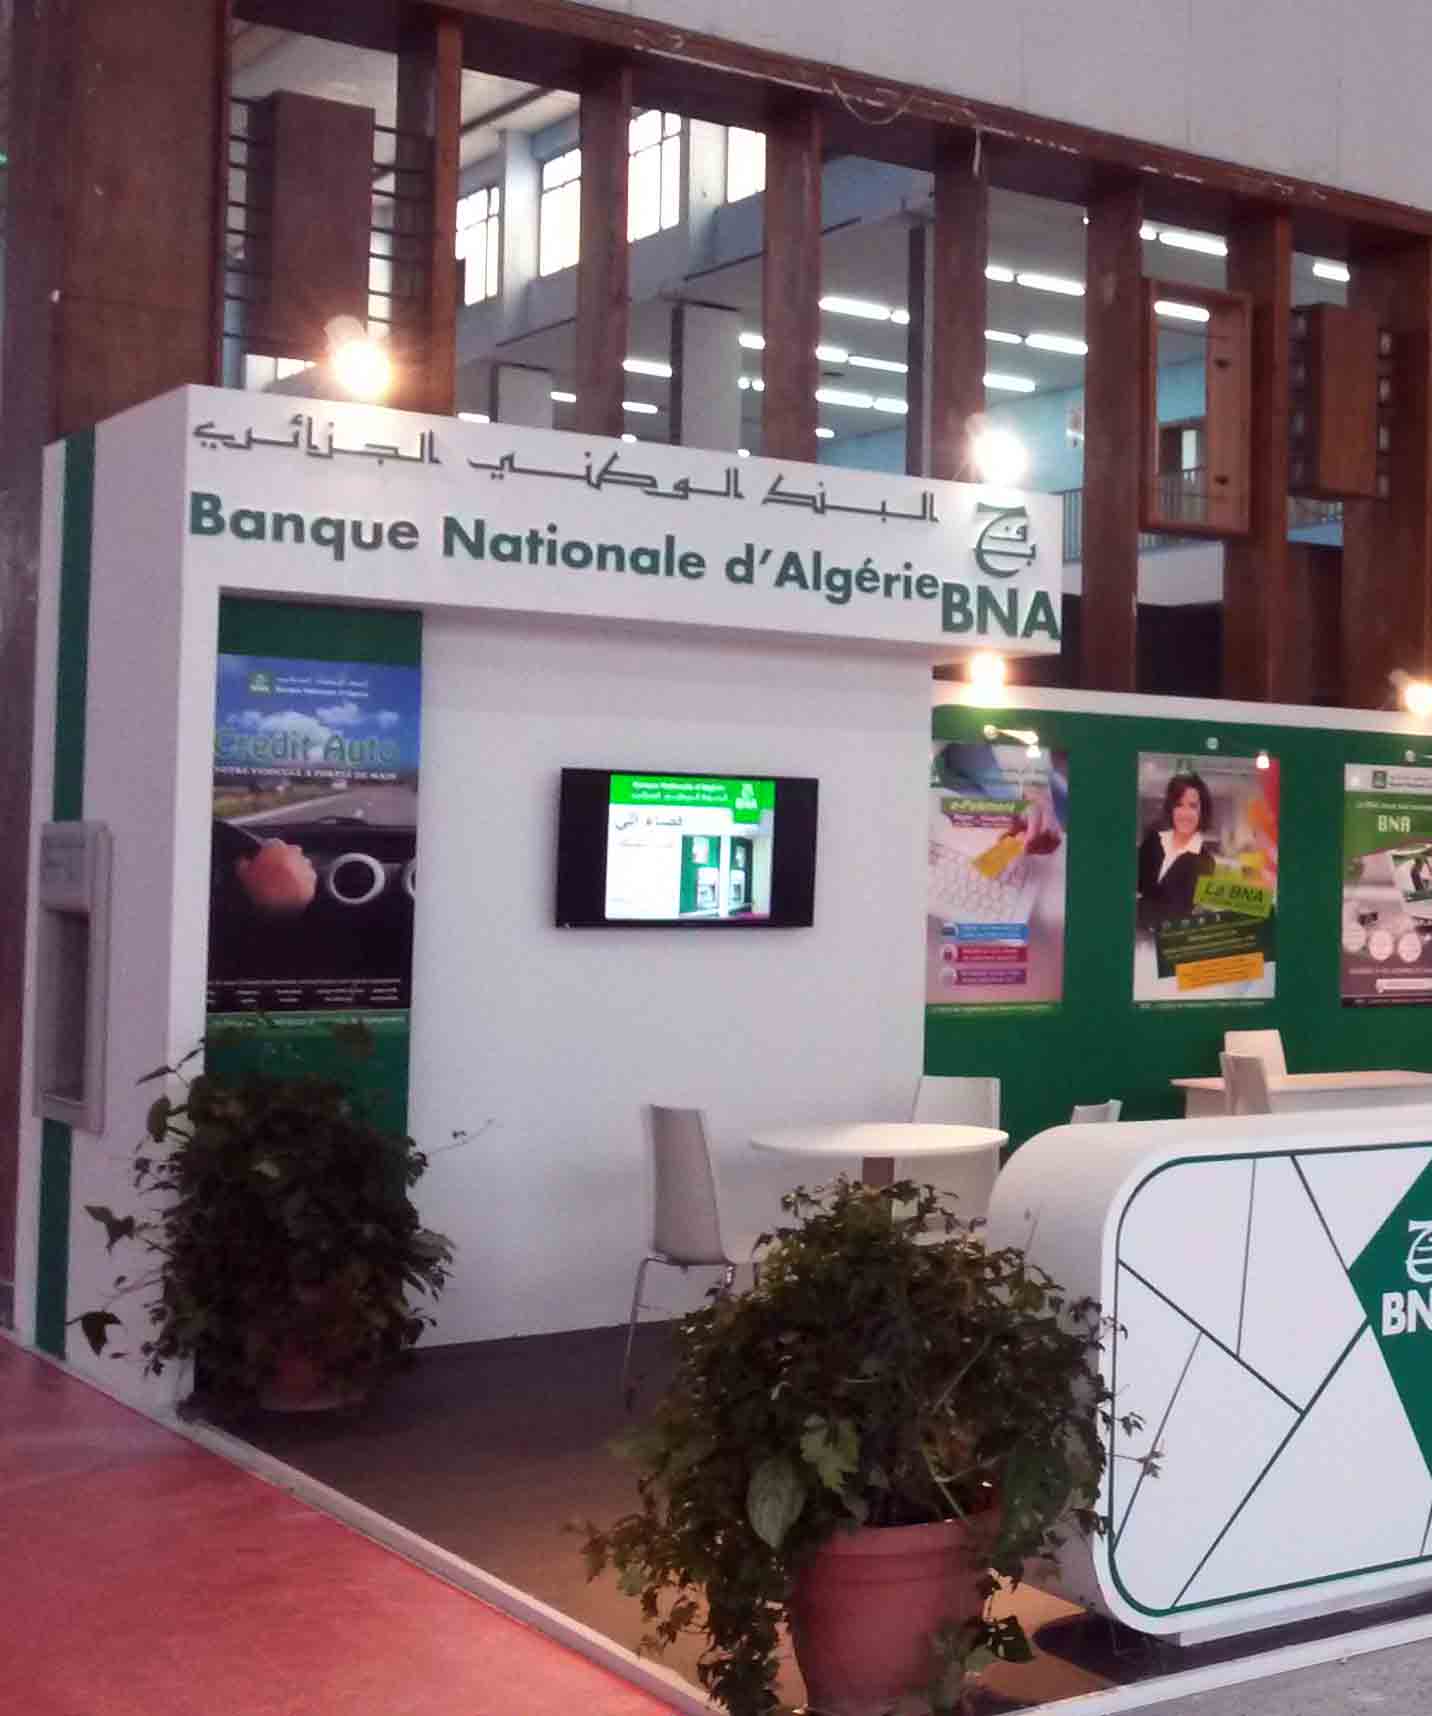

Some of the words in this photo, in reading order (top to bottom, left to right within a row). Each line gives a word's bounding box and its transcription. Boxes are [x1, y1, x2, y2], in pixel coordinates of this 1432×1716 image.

[192, 413, 442, 466] الجزائري
[467, 450, 745, 500] الوطني
[761, 473, 939, 523] البنك
[189, 491, 420, 562] Banque
[442, 515, 707, 581] Nationale
[724, 542, 939, 605] d'Algérie
[941, 581, 1062, 640] BNA
[1377, 814, 1411, 833] BNA
[1230, 885, 1264, 903] BNA
